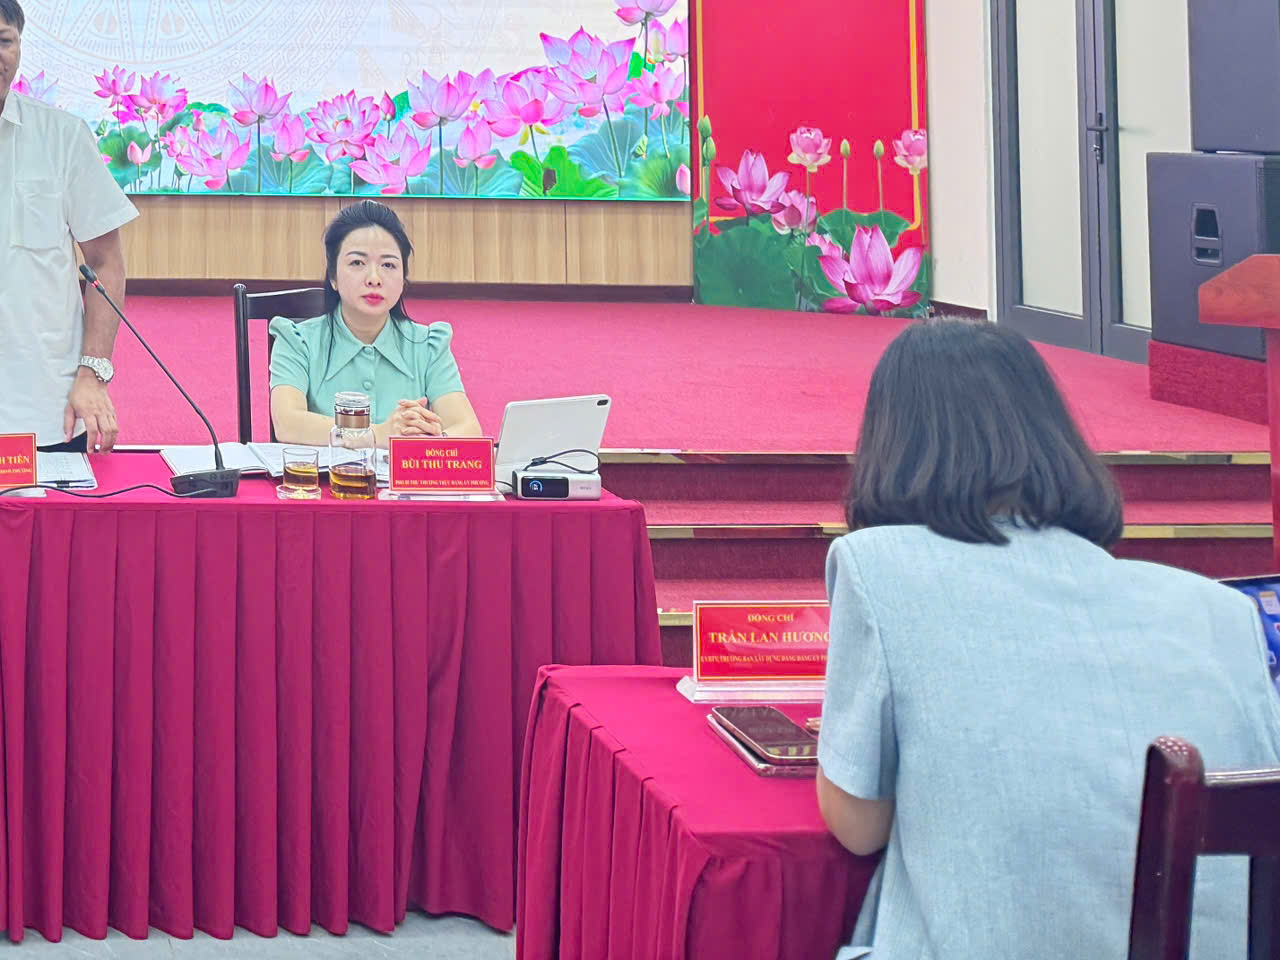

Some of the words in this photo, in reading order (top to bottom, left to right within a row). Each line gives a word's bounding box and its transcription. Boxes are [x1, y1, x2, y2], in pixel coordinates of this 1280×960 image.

[401, 458, 420, 469] BÙI
[422, 460, 444, 469] THU
[446, 460, 482, 470] TRANG
